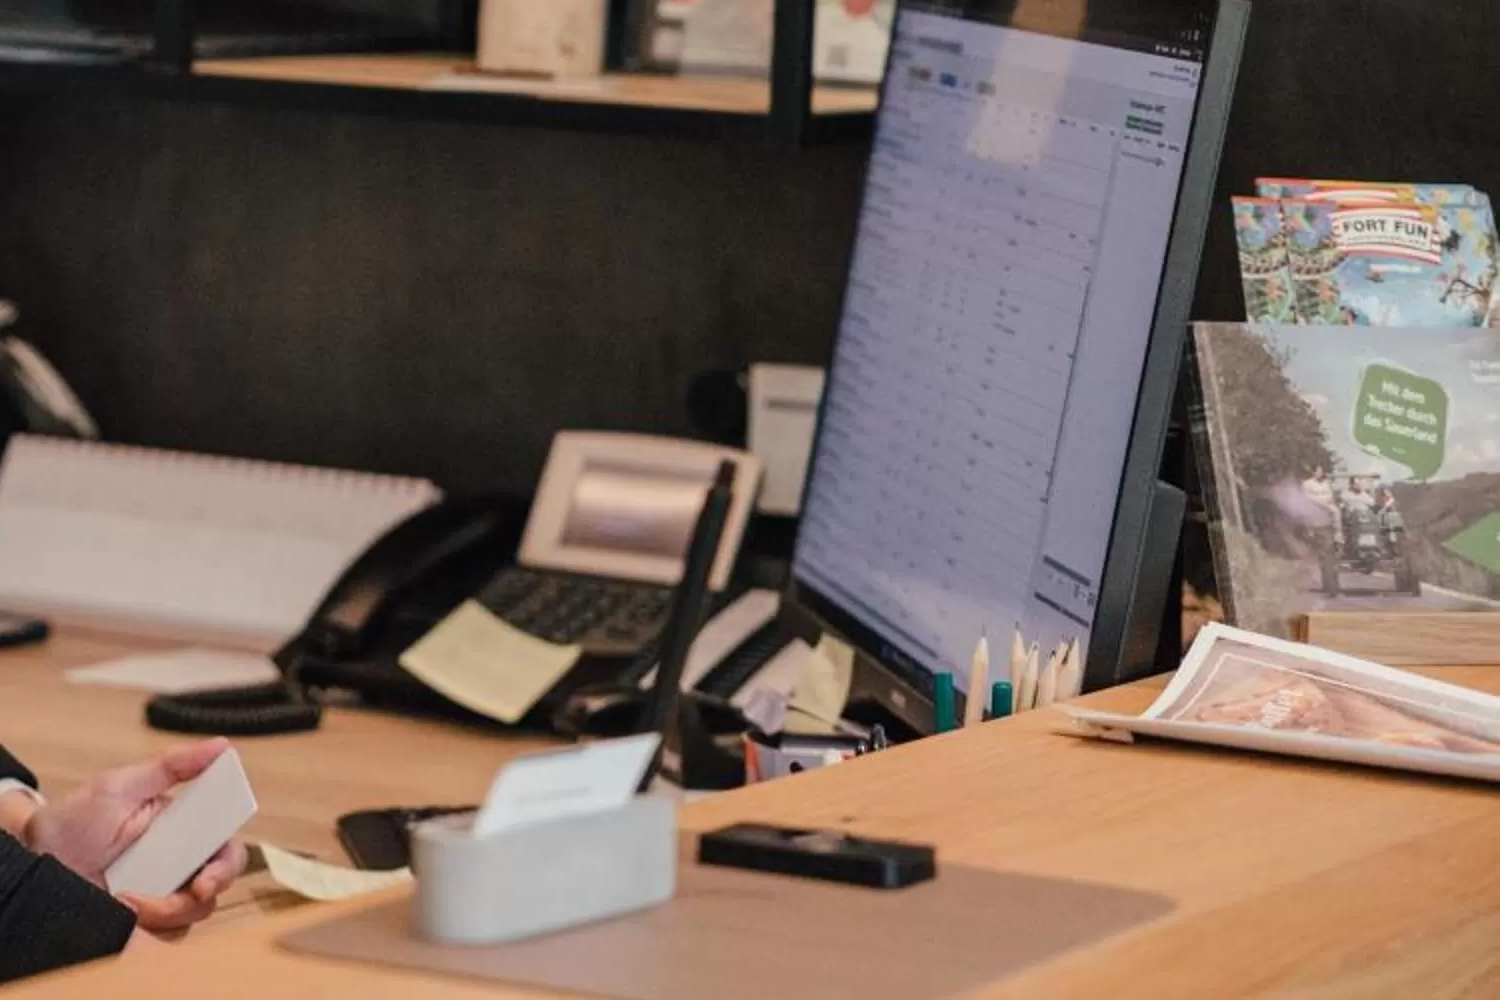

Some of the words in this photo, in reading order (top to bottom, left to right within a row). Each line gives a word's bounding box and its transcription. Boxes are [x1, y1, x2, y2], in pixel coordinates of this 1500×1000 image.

[1343, 218, 1385, 232] FORT
[1394, 220, 1429, 239] FUN
[1384, 416, 1438, 445] Sauerland
